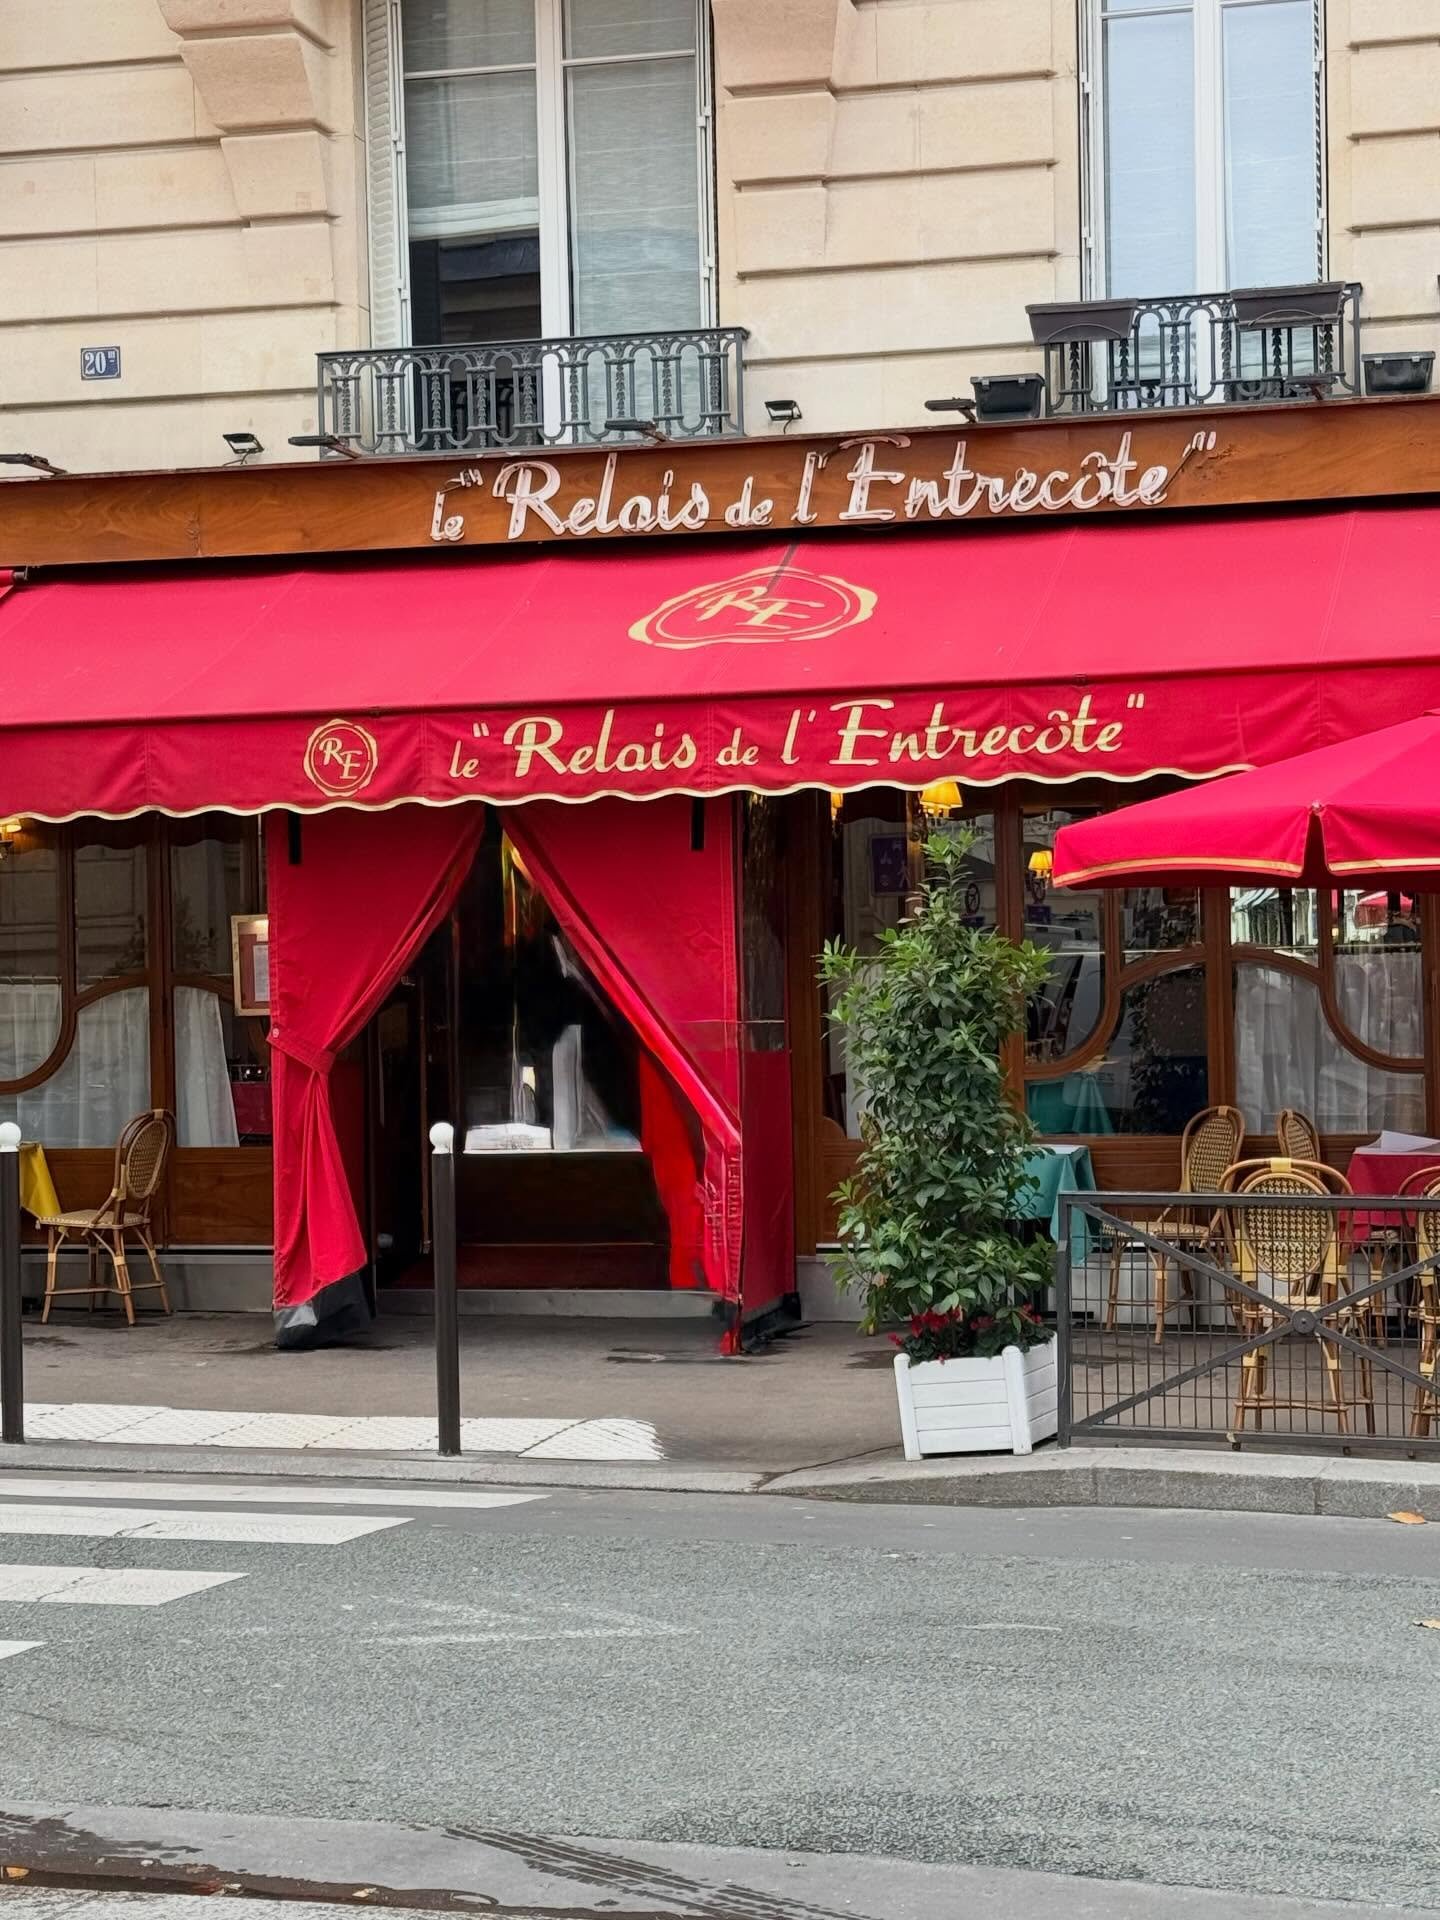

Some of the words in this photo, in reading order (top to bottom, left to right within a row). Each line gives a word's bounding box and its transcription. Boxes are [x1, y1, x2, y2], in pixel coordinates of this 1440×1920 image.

[430, 491, 465, 542] le
[724, 476, 774, 528] de
[694, 585, 825, 630] RE
[318, 737, 364, 780] RE
[448, 740, 480, 779] le
[715, 727, 759, 767] de
